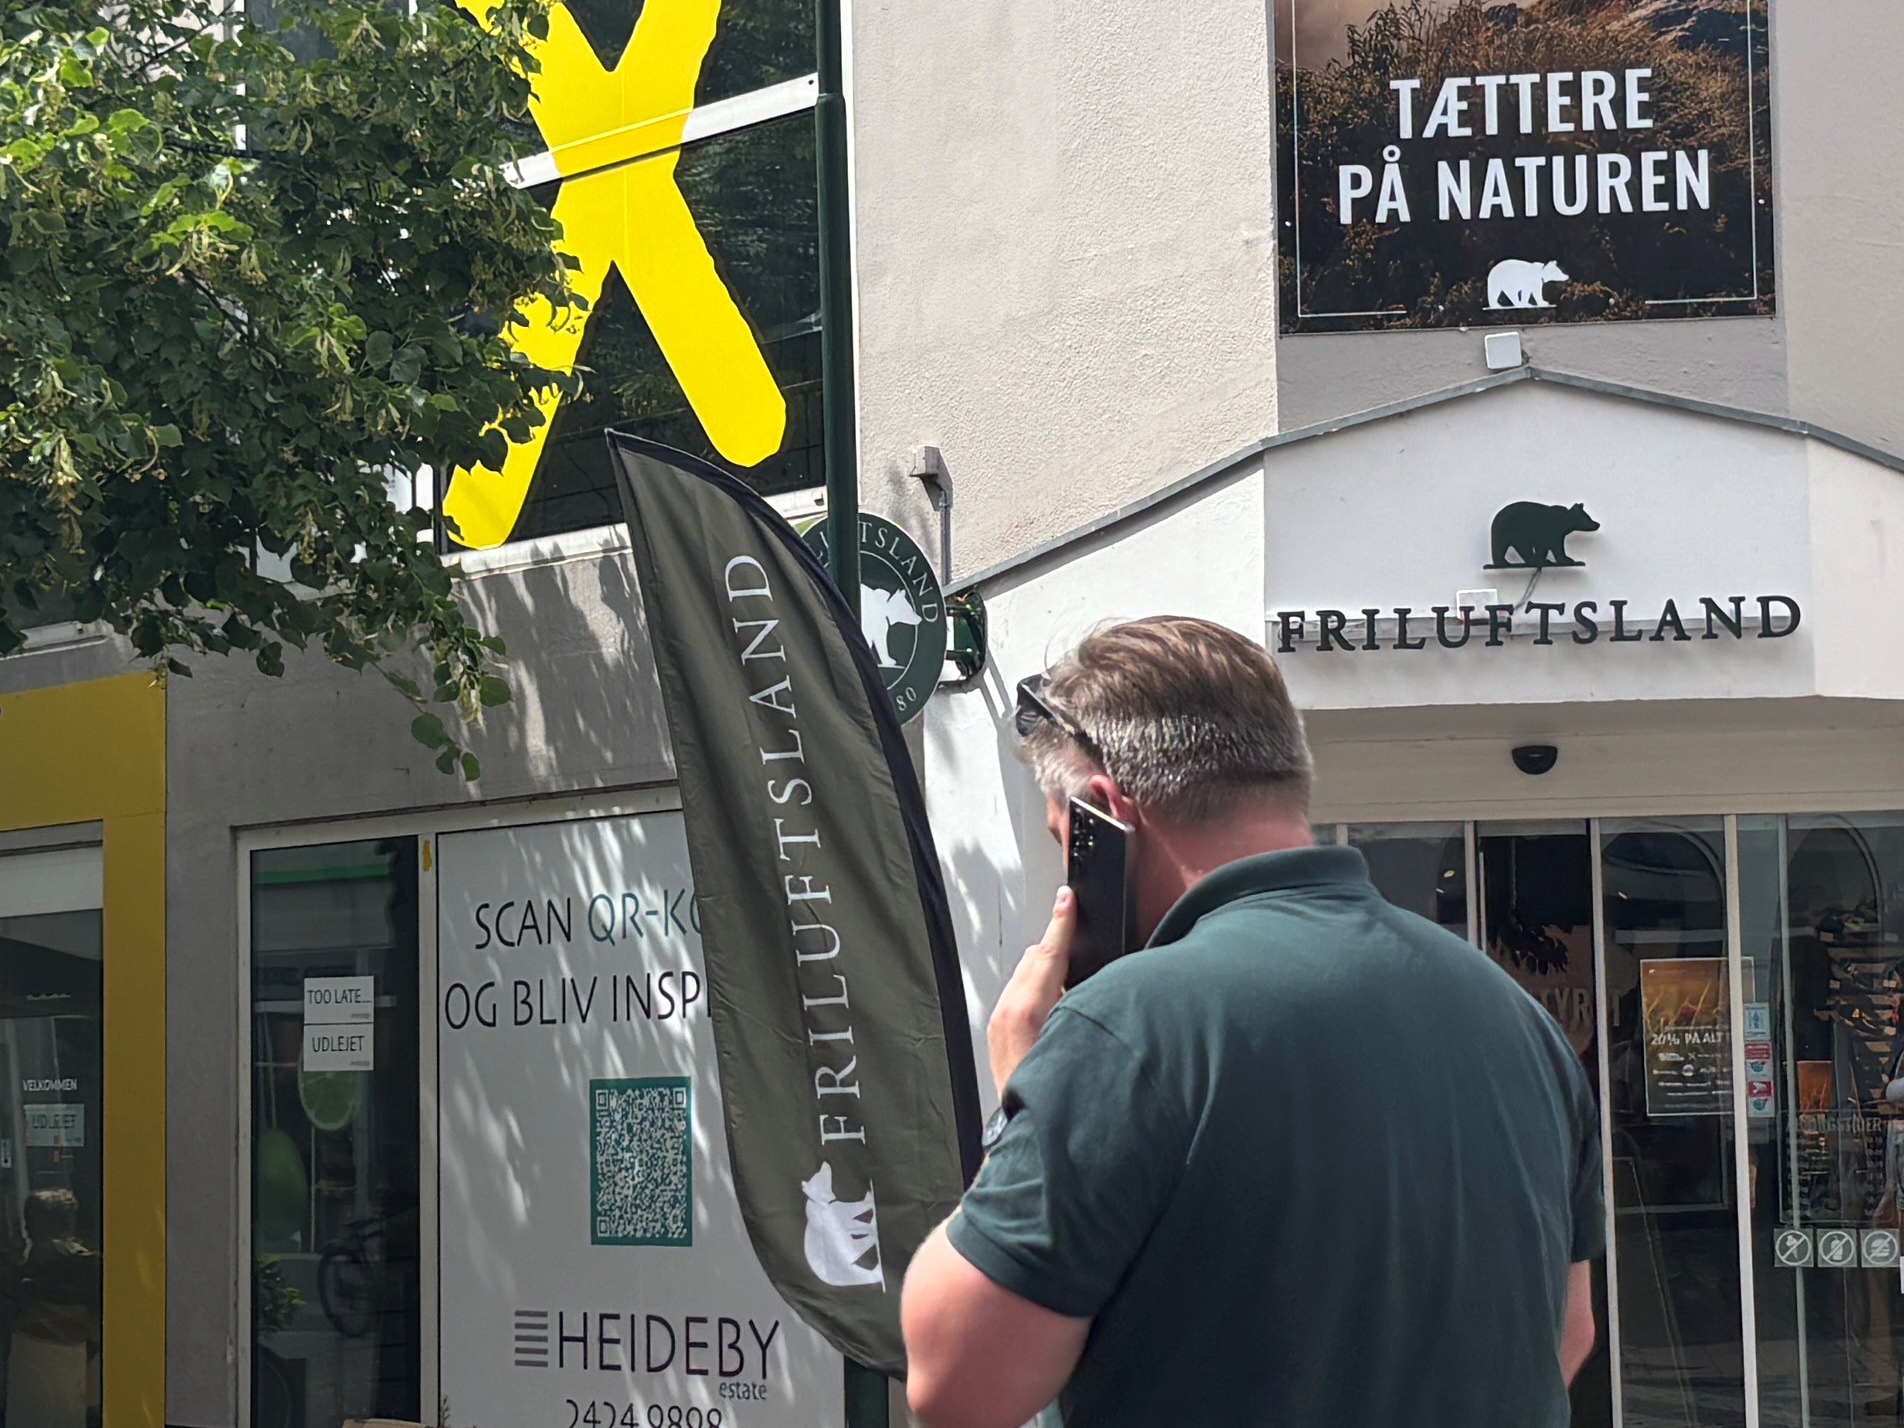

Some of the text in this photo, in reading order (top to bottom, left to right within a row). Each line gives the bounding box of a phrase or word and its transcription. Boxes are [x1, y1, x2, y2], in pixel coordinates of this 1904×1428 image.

[1389, 68, 1654, 140] TÆTTERE
[1338, 144, 1711, 225] PÅ NATUREN
[1276, 594, 1802, 654] FRILUFTSLAND
[723, 553, 867, 1149] FRILUFTSLAND
[475, 887, 703, 950] SCAN QR-K
[307, 988, 332, 1005] TOO
[443, 982, 497, 1030] OG
[513, 975, 598, 1026] BLIV
[312, 1035, 366, 1053] UDLEJET
[22, 1078, 78, 1092] VELKOMMEN
[557, 1311, 780, 1380] HEIDEBY
[718, 1378, 768, 1403] estate
